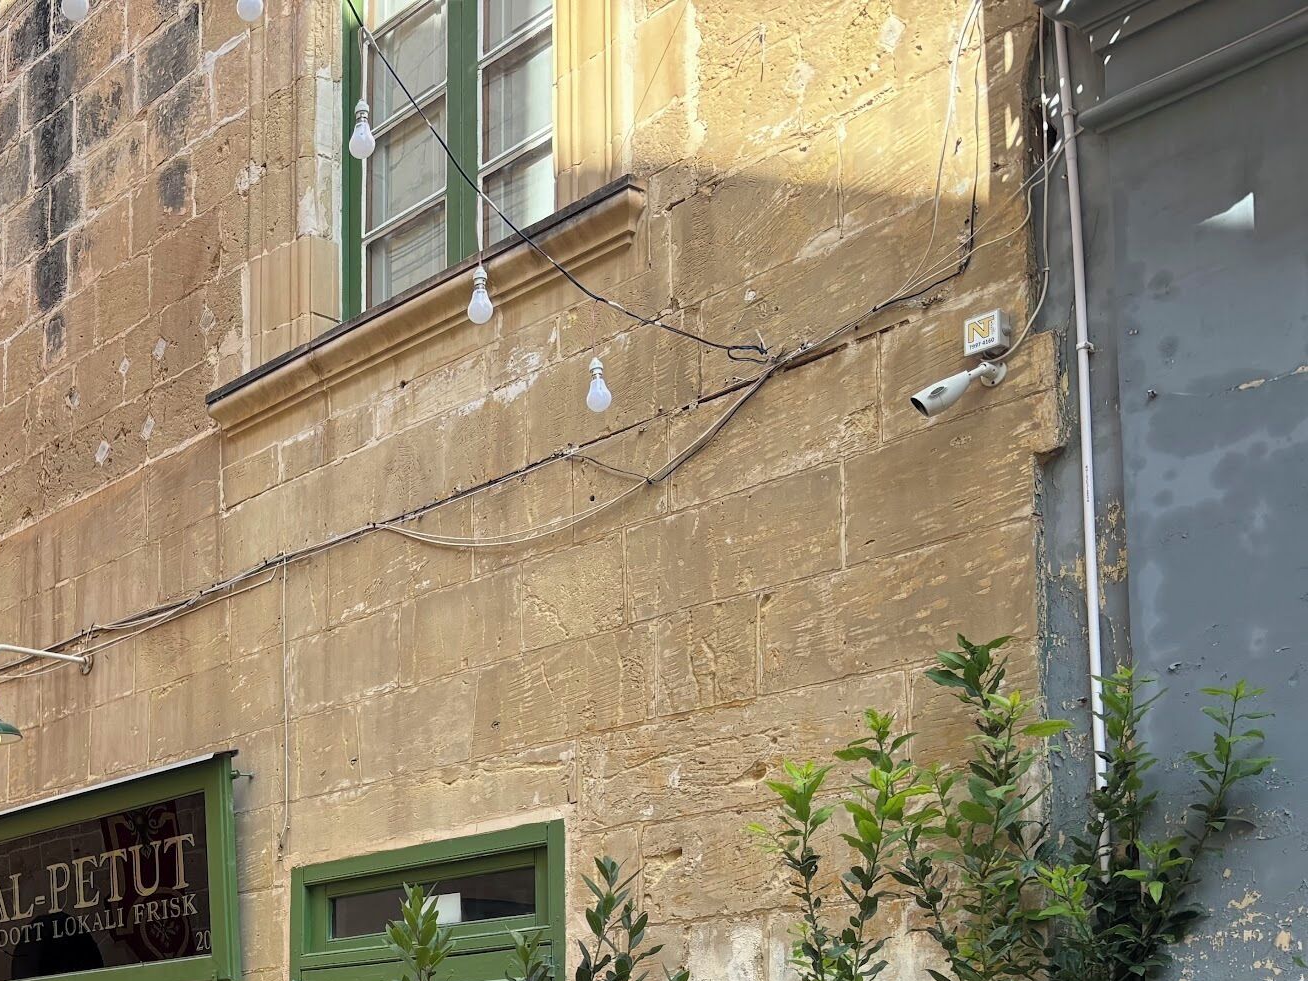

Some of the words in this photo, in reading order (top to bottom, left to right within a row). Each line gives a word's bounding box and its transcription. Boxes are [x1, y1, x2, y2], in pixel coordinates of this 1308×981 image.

[52, 907, 124, 939] LOKALI
[133, 893, 198, 925] FRISK
[195, 930, 212, 951] 20
